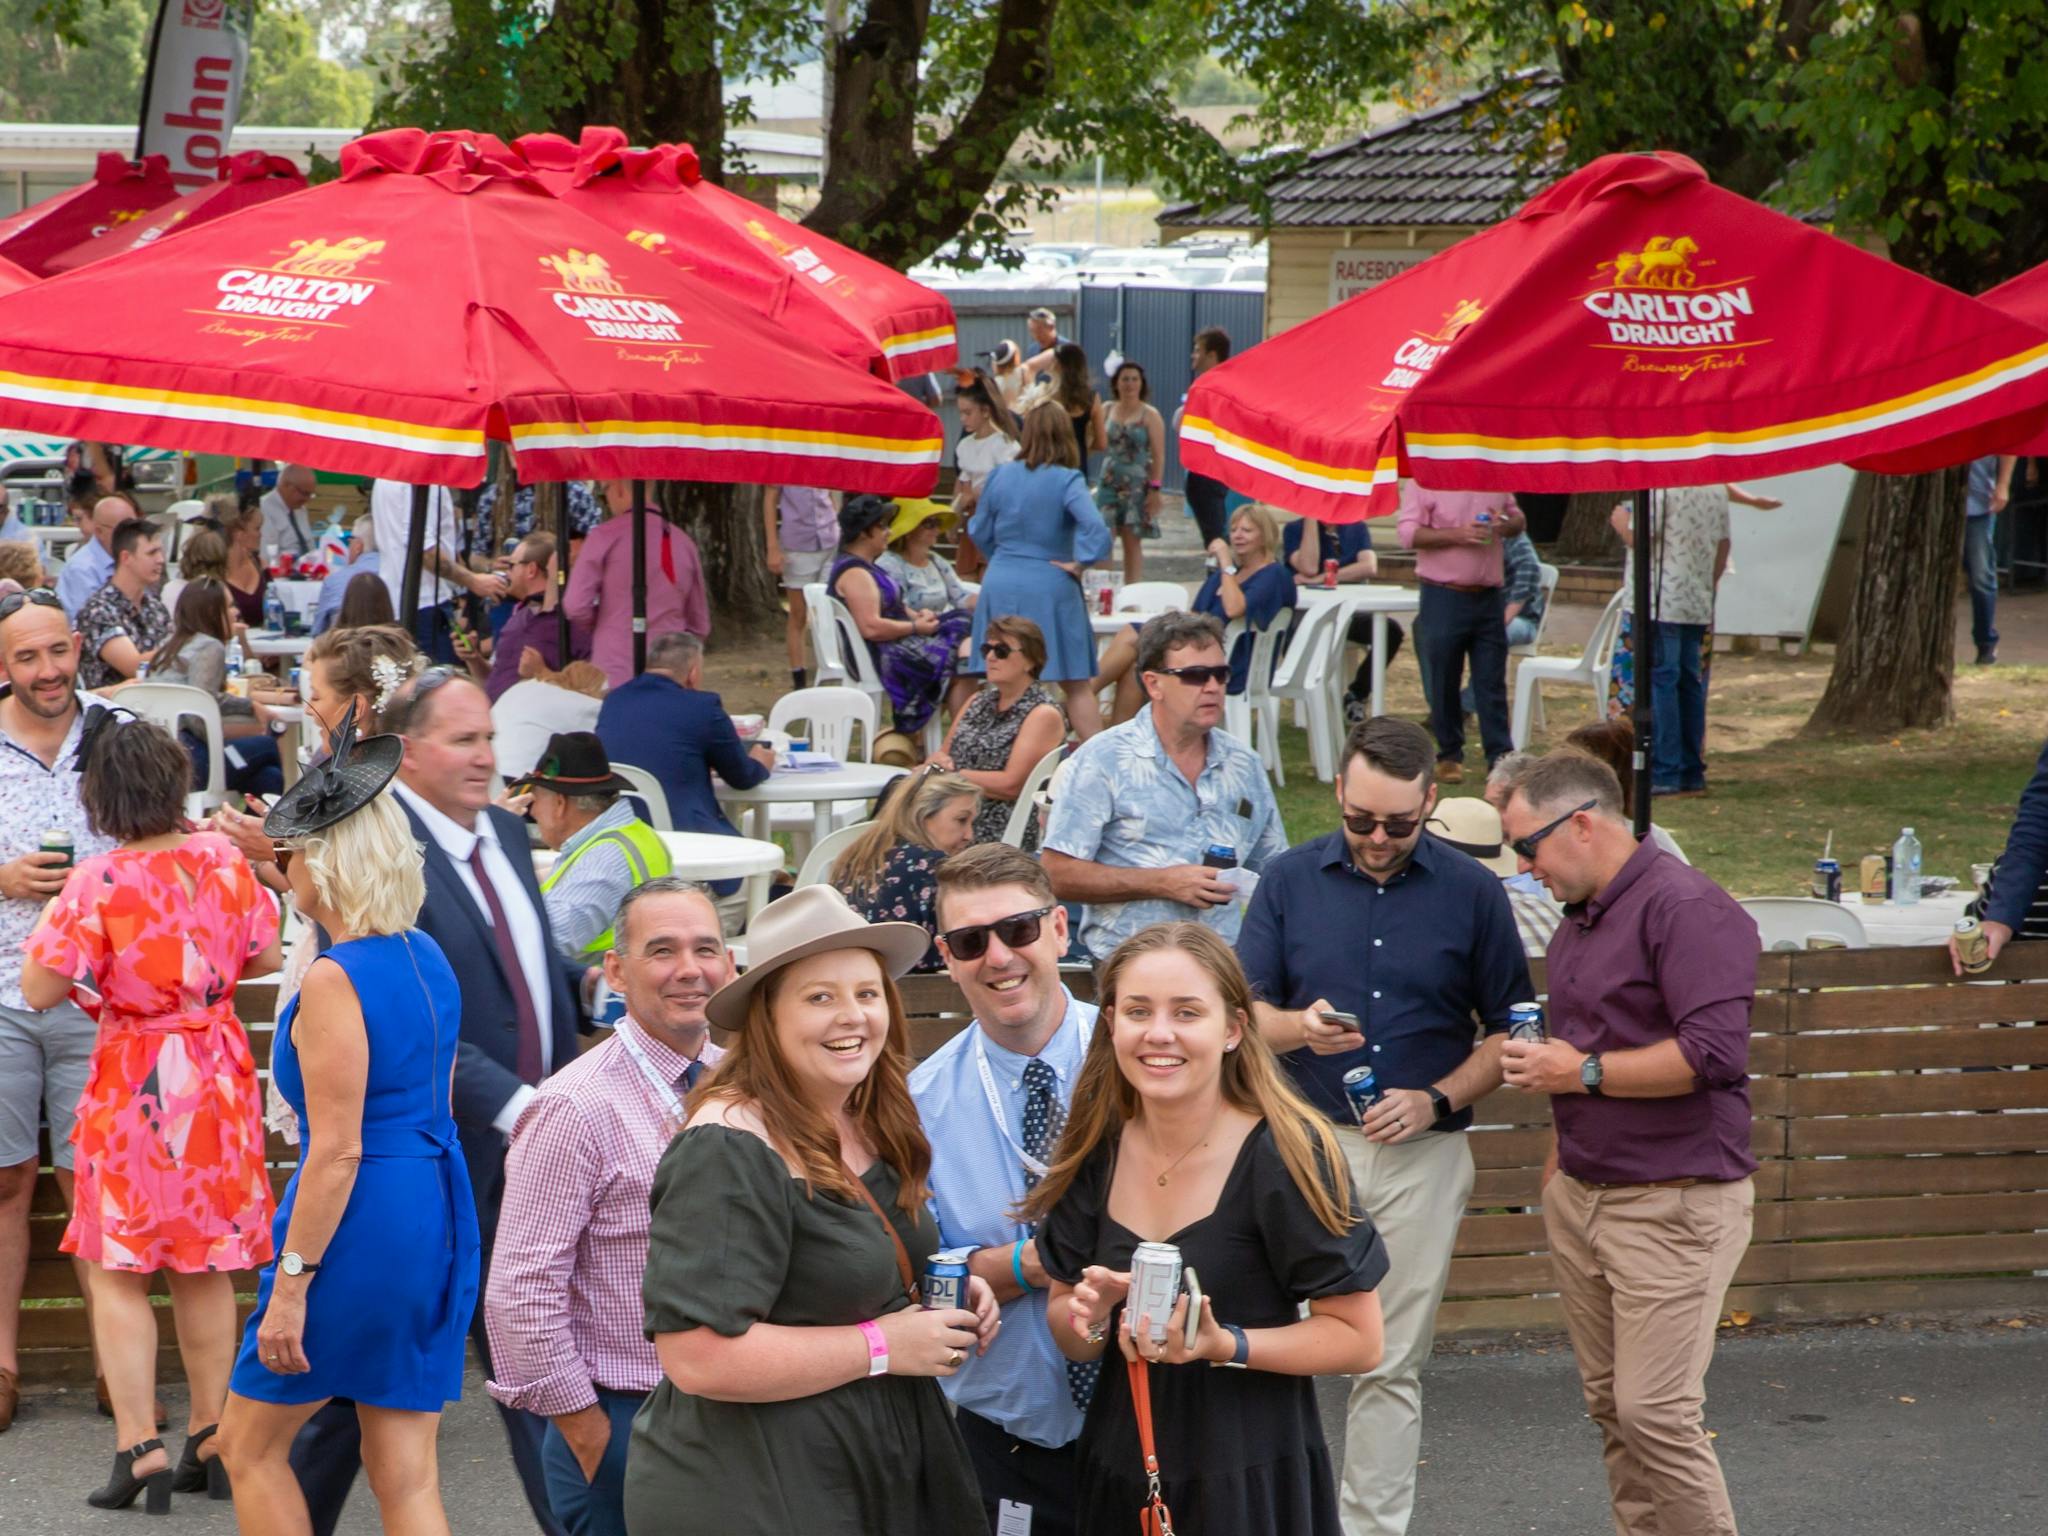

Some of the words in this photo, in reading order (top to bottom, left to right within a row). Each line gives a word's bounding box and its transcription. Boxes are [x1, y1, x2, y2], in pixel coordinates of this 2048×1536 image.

[216, 269, 376, 306] CARLTON
[214, 293, 341, 321] DRAUGHT
[552, 292, 684, 325] CARLTON
[1583, 287, 1754, 323] CARLTON
[584, 318, 683, 341] DRAUGHT
[1608, 320, 1736, 345] DRAUGHT
[1622, 353, 1696, 382] Brewery
[1697, 352, 1747, 372] Fresh
